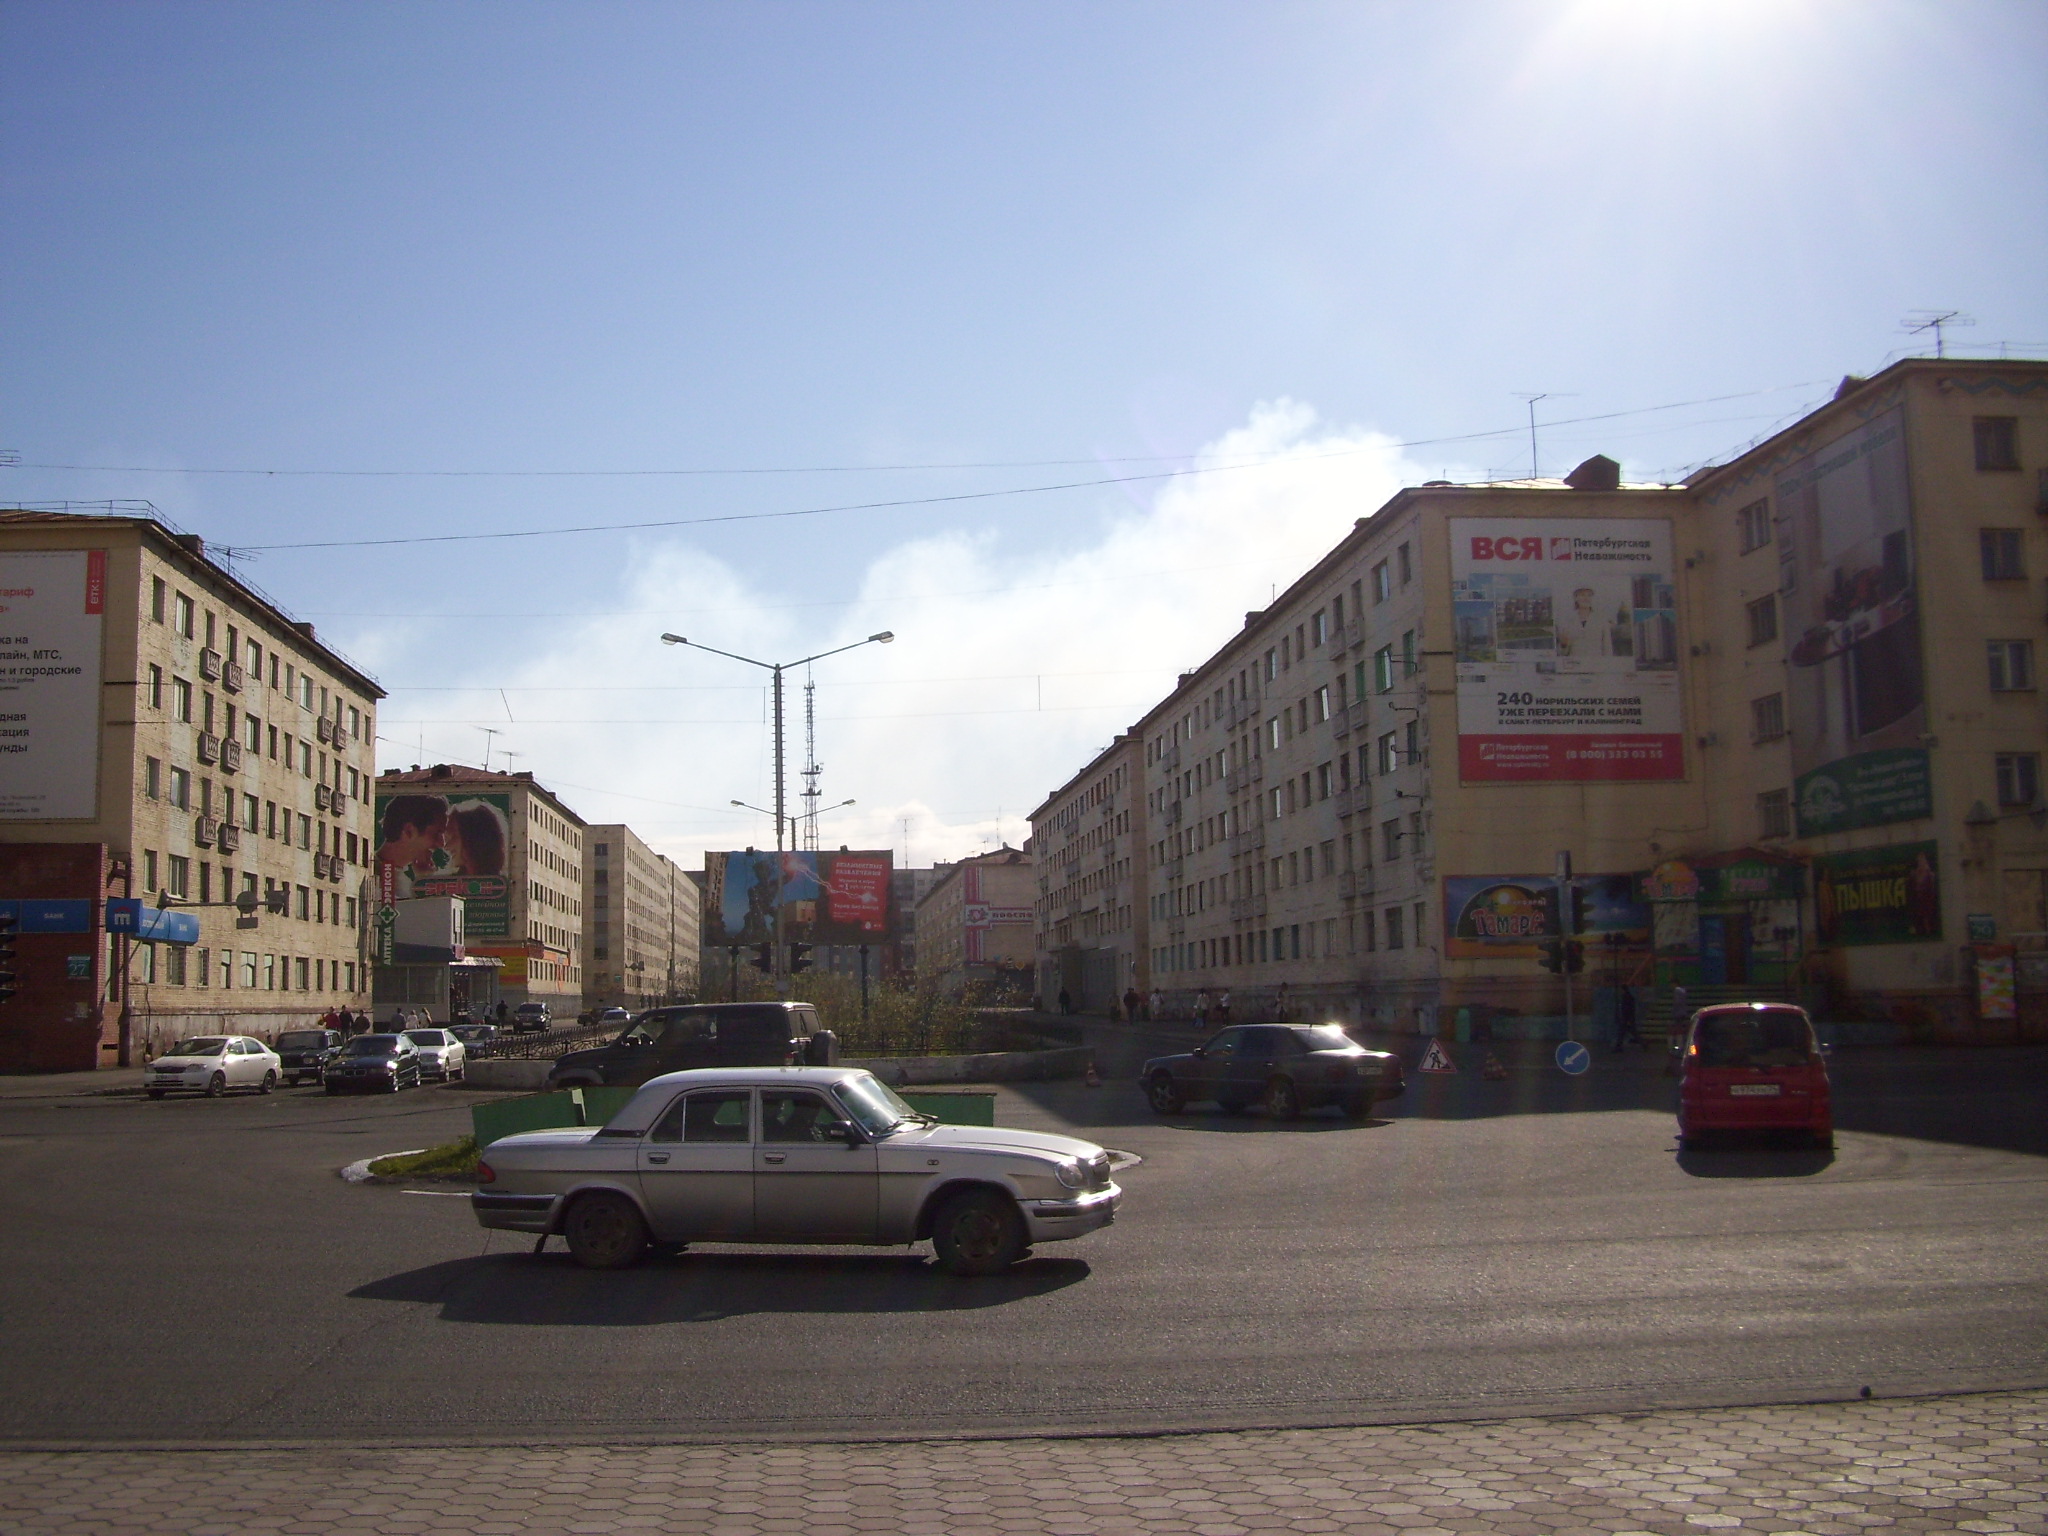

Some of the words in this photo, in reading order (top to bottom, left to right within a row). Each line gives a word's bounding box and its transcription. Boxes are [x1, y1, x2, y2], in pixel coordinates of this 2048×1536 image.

[1471, 536, 1542, 561] ВСЯ
[1574, 551, 1652, 561] Недвижимость
[15, 636, 29, 644] на
[33, 650, 62, 660] МТС,
[9, 667, 16, 675] и
[19, 666, 82, 677] городские
[1497, 692, 1533, 706] 240
[1535, 697, 1604, 705] НОРИЛЬСКИХ
[1607, 695, 1641, 705] СЕМЕЙ
[1499, 708, 1525, 716] УЖЕ
[1528, 708, 1595, 716] ПЕРЕЕХАЛИ
[1598, 708, 1604, 716] С
[1607, 708, 1641, 716] НАМИ
[1608, 750, 1629, 759] 333
[1833, 877, 1908, 914] ПЫШКА
[383, 926, 392, 966] АПТЕКА
[68, 963, 87, 976] 27
